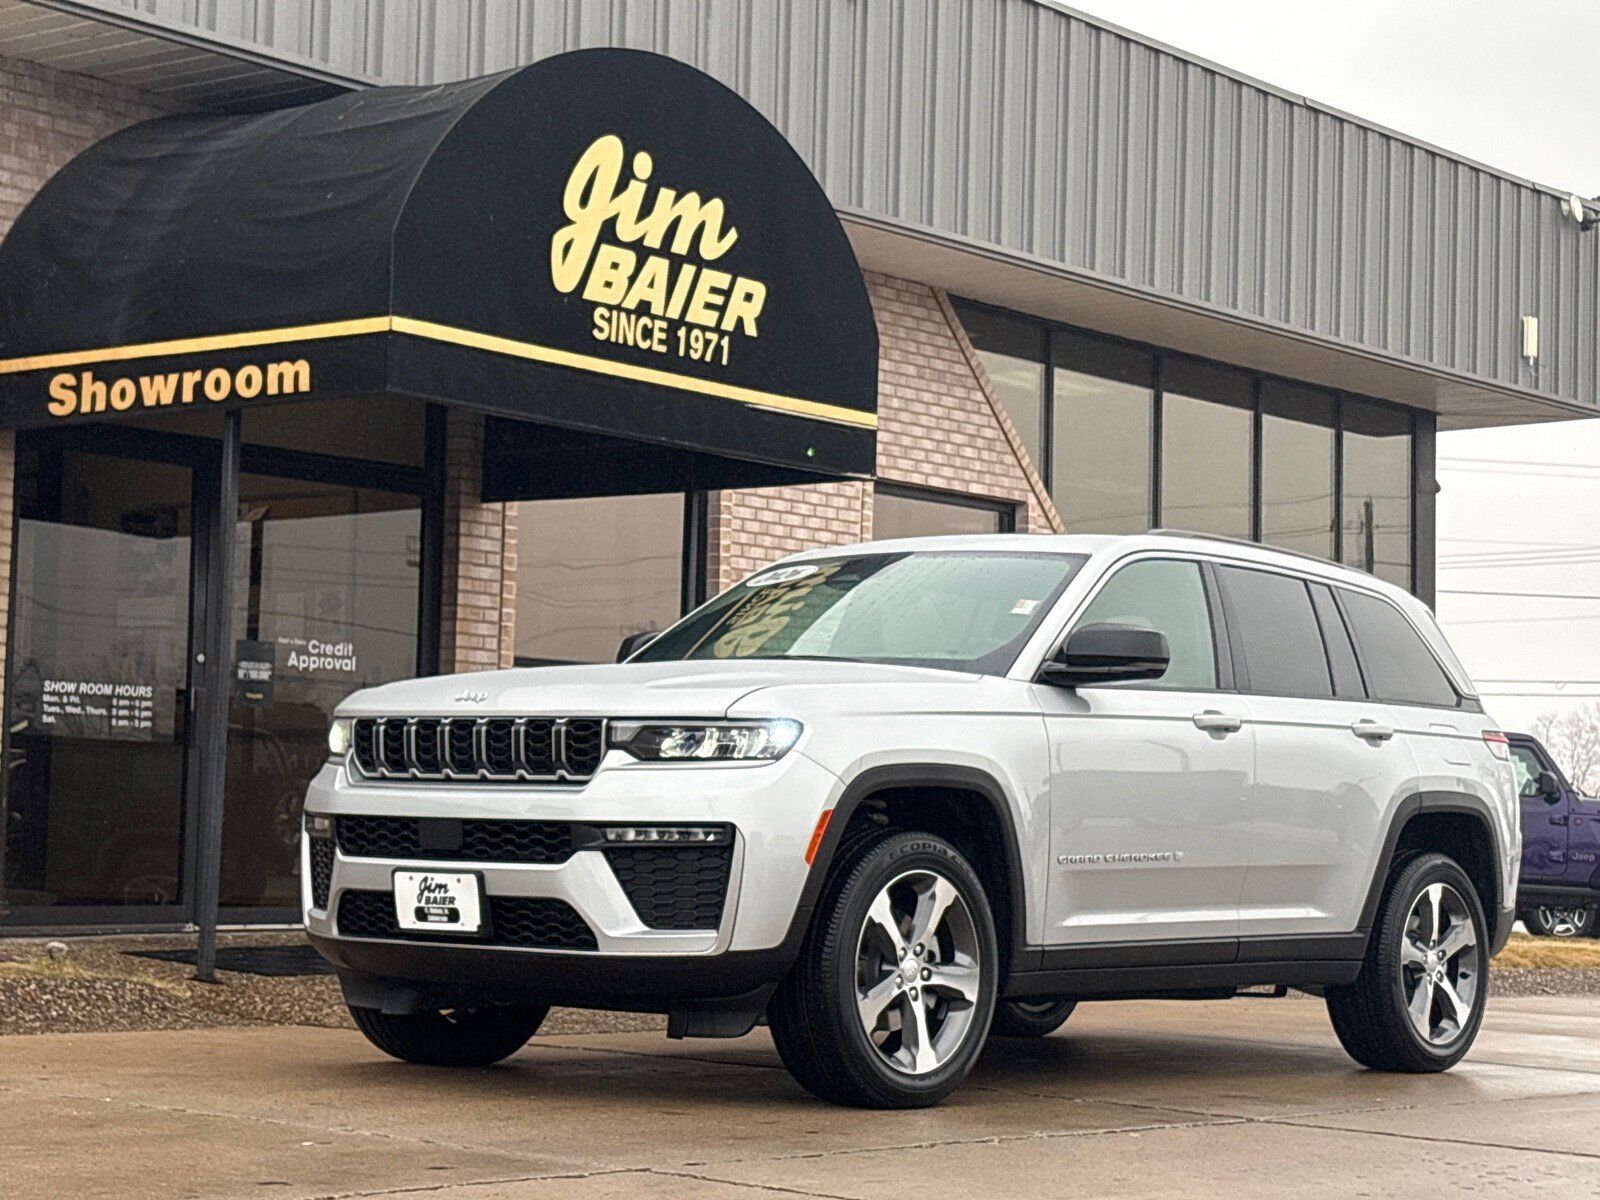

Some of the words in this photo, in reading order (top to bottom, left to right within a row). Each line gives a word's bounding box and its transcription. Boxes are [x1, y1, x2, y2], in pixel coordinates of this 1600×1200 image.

[582, 243, 766, 337] BAIER
[592, 307, 668, 353] SINCE
[677, 325, 730, 365] 1971
[48, 359, 310, 416] Showroom
[308, 640, 353, 656] Credit
[287, 651, 356, 672] Approval
[43, 680, 77, 693] SHOW
[79, 682, 113, 695] ROOM
[115, 685, 153, 698] HOURS
[1057, 854, 1102, 865] GRAND
[1104, 852, 1172, 863] CHEROKEE
[1571, 851, 1596, 862] Jeep
[424, 895, 457, 906] BAIER
